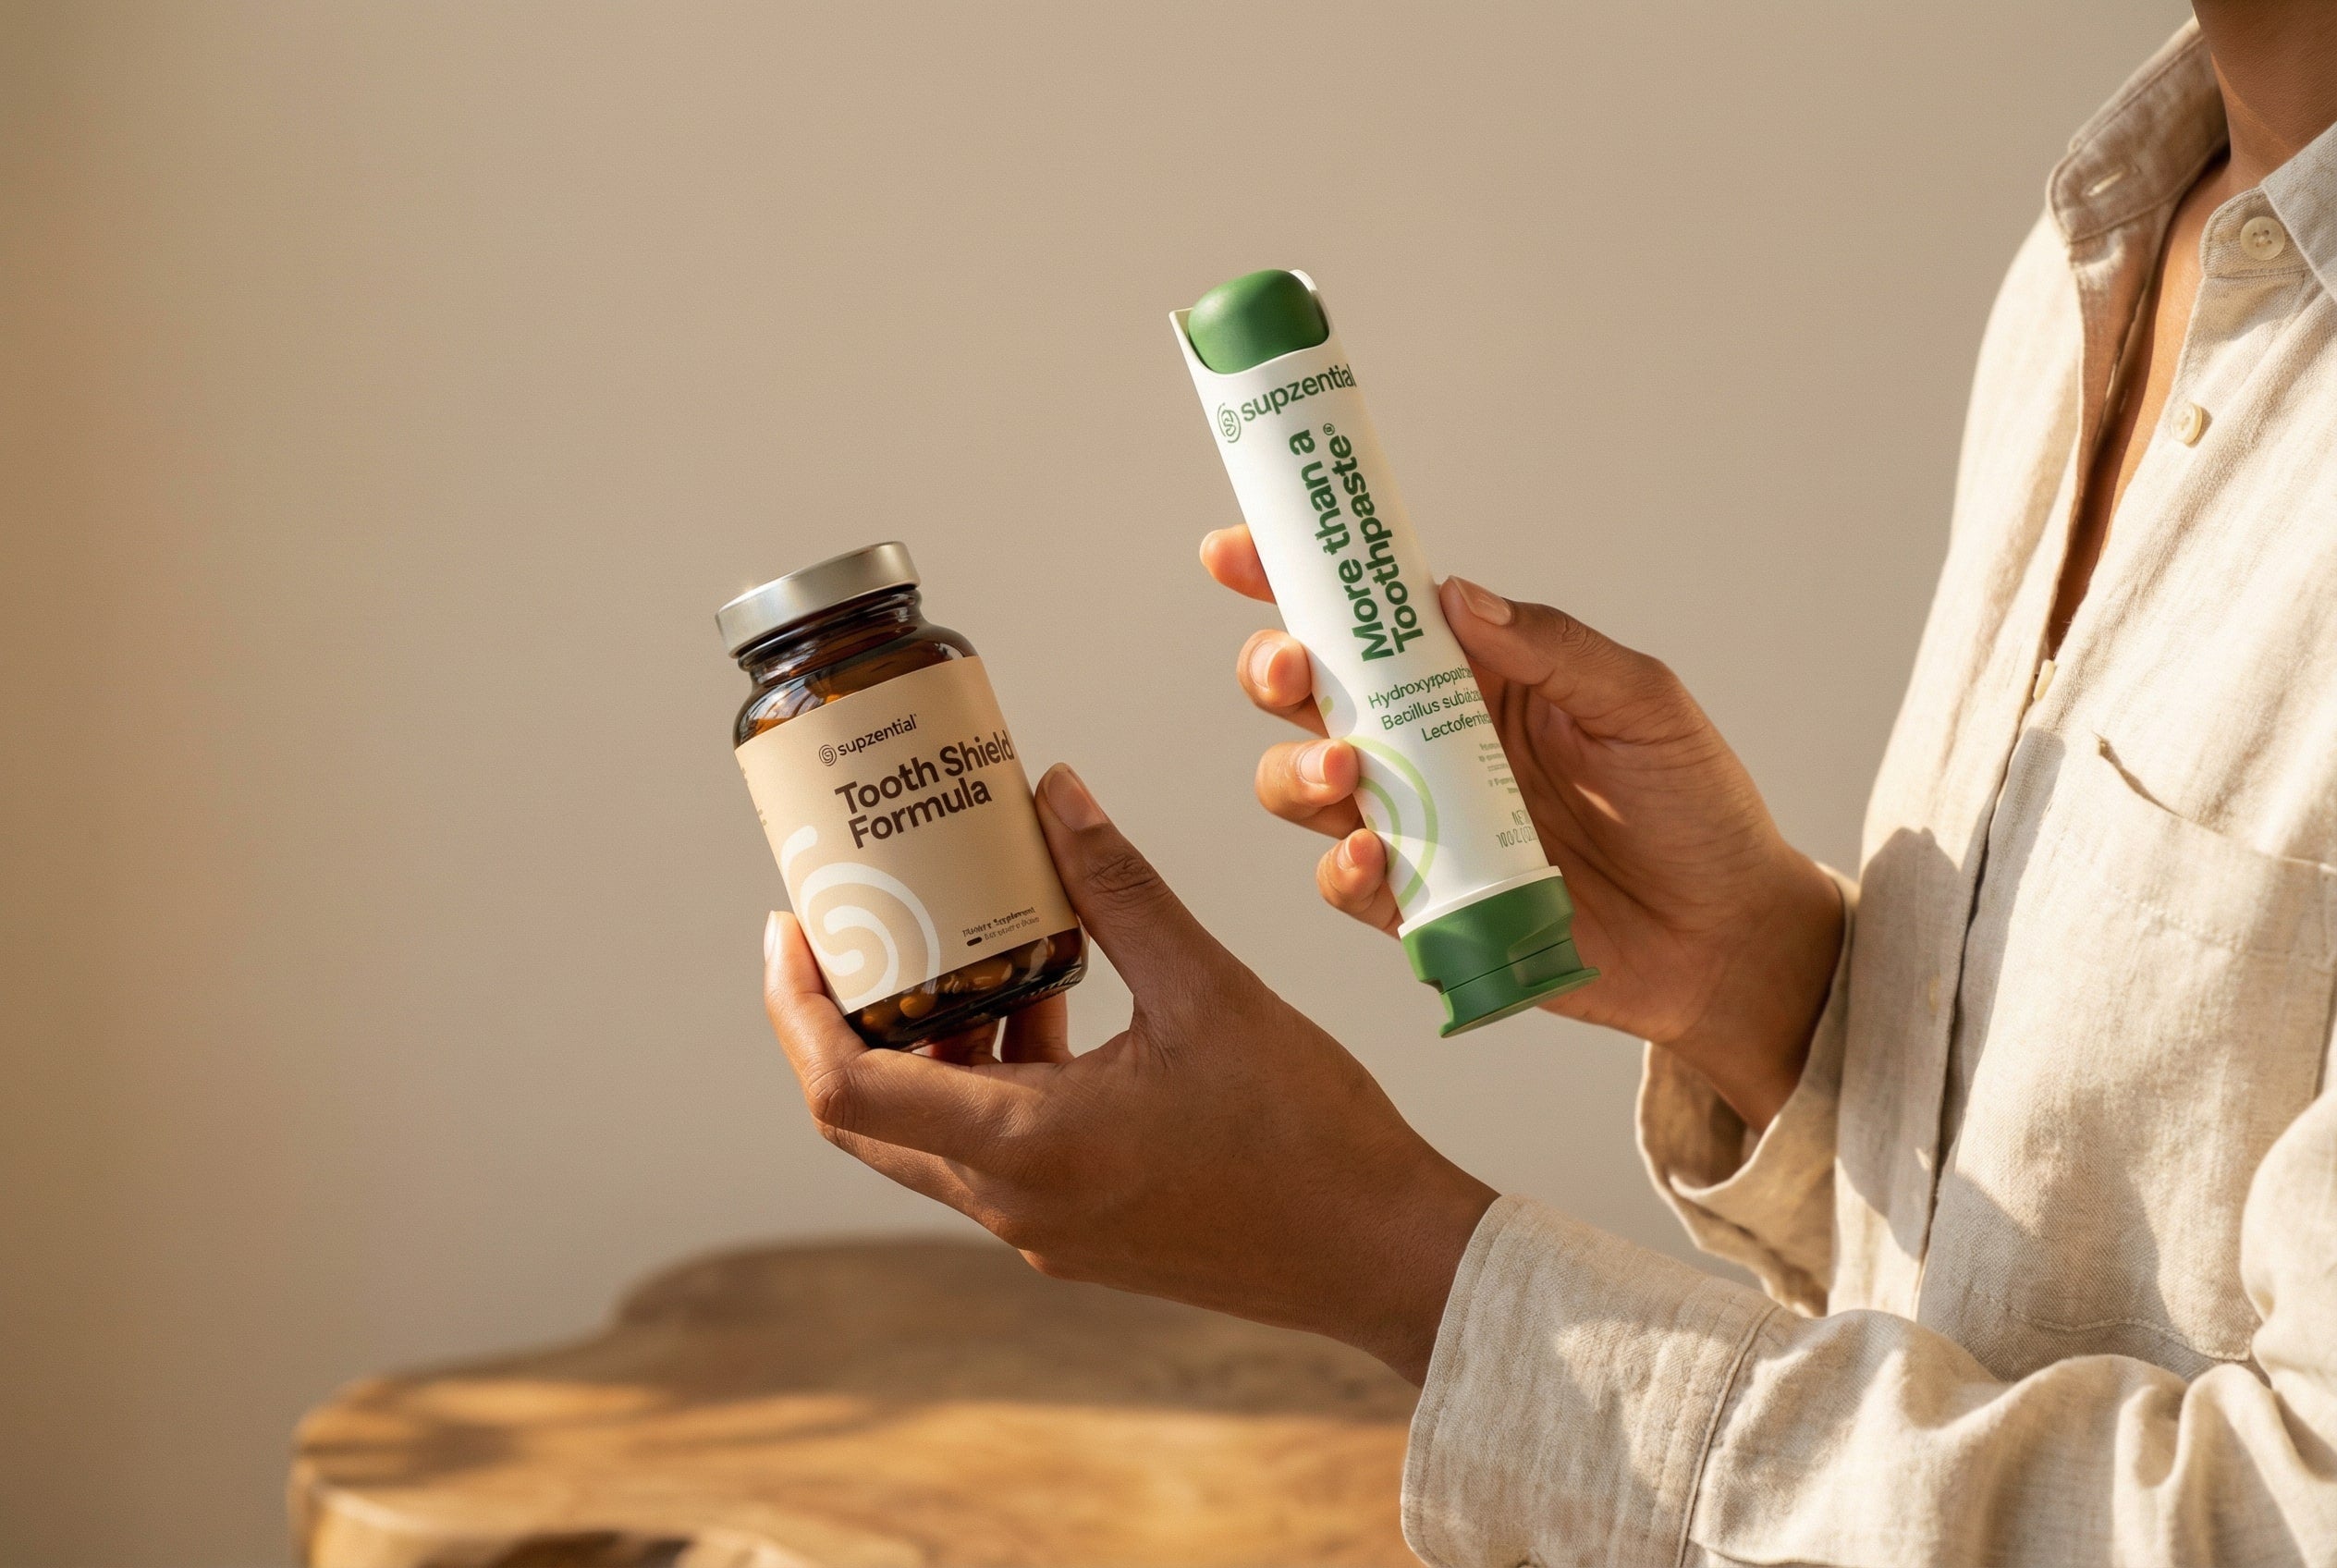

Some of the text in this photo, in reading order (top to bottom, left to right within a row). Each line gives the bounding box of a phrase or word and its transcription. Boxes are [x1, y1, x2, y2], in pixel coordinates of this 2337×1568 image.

[1241, 363, 1357, 422] supzential
[1289, 429, 1394, 662] More than a
[838, 714, 917, 758] supzential
[1380, 701, 1440, 730] Bacillus
[834, 729, 1015, 815] Tooth Shield
[848, 777, 993, 850] Formula
